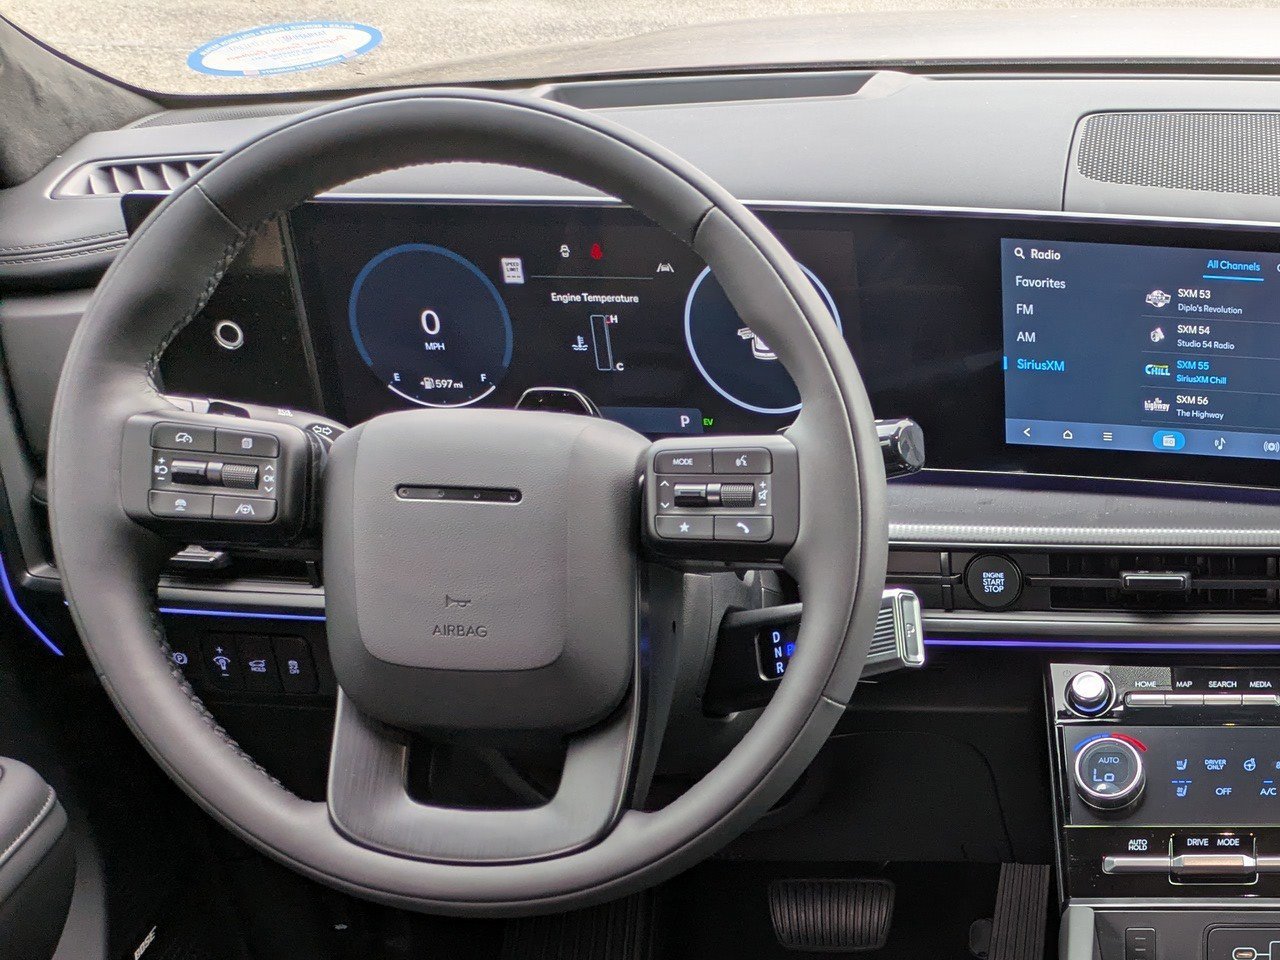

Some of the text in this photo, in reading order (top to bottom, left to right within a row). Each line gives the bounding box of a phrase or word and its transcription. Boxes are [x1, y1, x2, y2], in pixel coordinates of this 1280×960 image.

[1031, 249, 1061, 261] Radio
[1207, 260, 1261, 271] All Channels
[1015, 276, 1066, 289] Favorites
[551, 292, 639, 306] Engine Temperature
[1178, 288, 1198, 299] SXM
[1199, 289, 1211, 299] 53
[1016, 304, 1034, 315] FM
[1178, 303, 1243, 315] Diplo's Revolution
[421, 309, 441, 335] 0
[610, 315, 618, 323] H
[1177, 324, 1210, 335] SXM 54
[1016, 331, 1036, 343] AM
[425, 342, 445, 351] MPH
[1177, 339, 1235, 350] Studio 54 Radio
[616, 363, 624, 371] C
[1017, 359, 1065, 371] SiriusXM
[1145, 364, 1170, 376] CHILL
[1177, 360, 1209, 371] SXM 55
[394, 373, 400, 382] E
[481, 374, 487, 382] F
[1176, 374, 1227, 385] SiriusXM Chill
[435, 379, 453, 389] 597
[1176, 394, 1208, 406] SXM 56
[1176, 409, 1224, 421] The Highway
[681, 416, 690, 427] P
[703, 418, 713, 426] EV
[673, 458, 693, 466] MODE
[982, 578, 1005, 586] START
[432, 624, 488, 638] AIRBAG
[772, 632, 780, 643] D
[774, 647, 782, 658] N
[776, 662, 784, 673] R
[1215, 788, 1232, 796] OFF
[1260, 788, 1277, 796] A/C
[1187, 838, 1240, 847] DRIVE MODE
